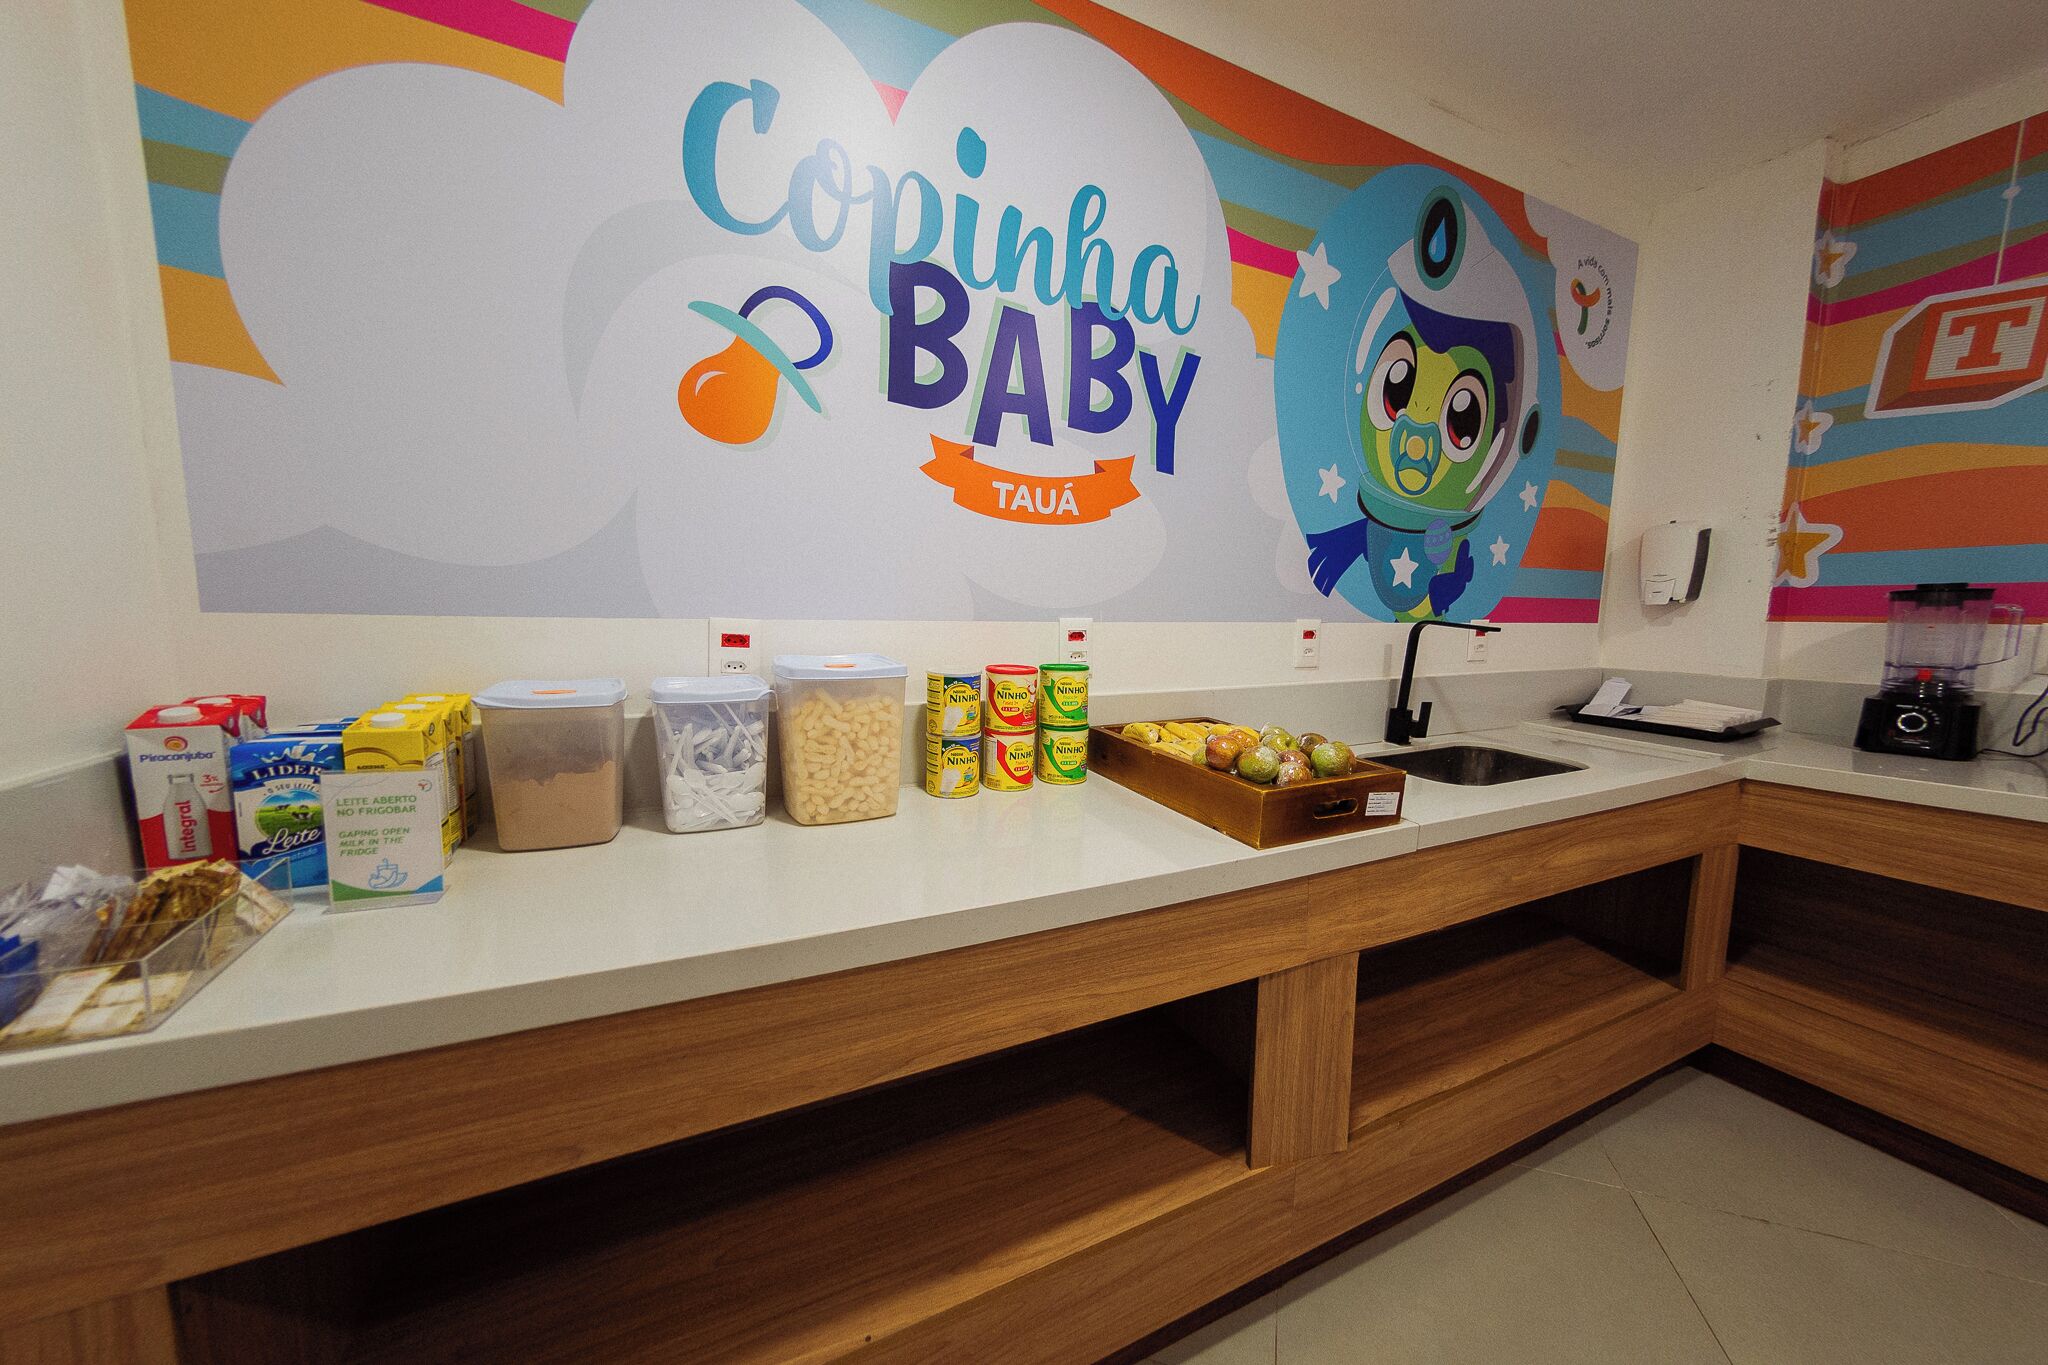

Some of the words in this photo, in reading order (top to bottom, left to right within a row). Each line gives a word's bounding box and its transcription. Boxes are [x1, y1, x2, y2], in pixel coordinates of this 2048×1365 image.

[682, 79, 1200, 335] Copinha
[1578, 259, 1583, 270] A
[1584, 256, 1598, 269] vida
[1598, 265, 1610, 286] com
[888, 260, 1202, 476] BABY
[992, 482, 1080, 516] TAUÁ
[996, 690, 1028, 700] NINHO
[1057, 686, 1085, 694] NINHO
[949, 694, 978, 703] NINHO
[1009, 750, 1033, 760] NINHO
[1056, 745, 1084, 754] NINHO
[947, 756, 977, 765] NINHO
[336, 797, 369, 807] LEITE
[373, 795, 417, 805] ABERTO
[337, 808, 354, 816] NO
[358, 805, 416, 815] FRIGOBAR
[338, 829, 378, 838] GAPING
[382, 827, 410, 836] OPEN
[262, 828, 320, 854] Leite
[339, 838, 365, 847] MILK
[369, 837, 379, 845] IN
[384, 836, 404, 844] THE
[340, 847, 379, 856] FRIDGE
